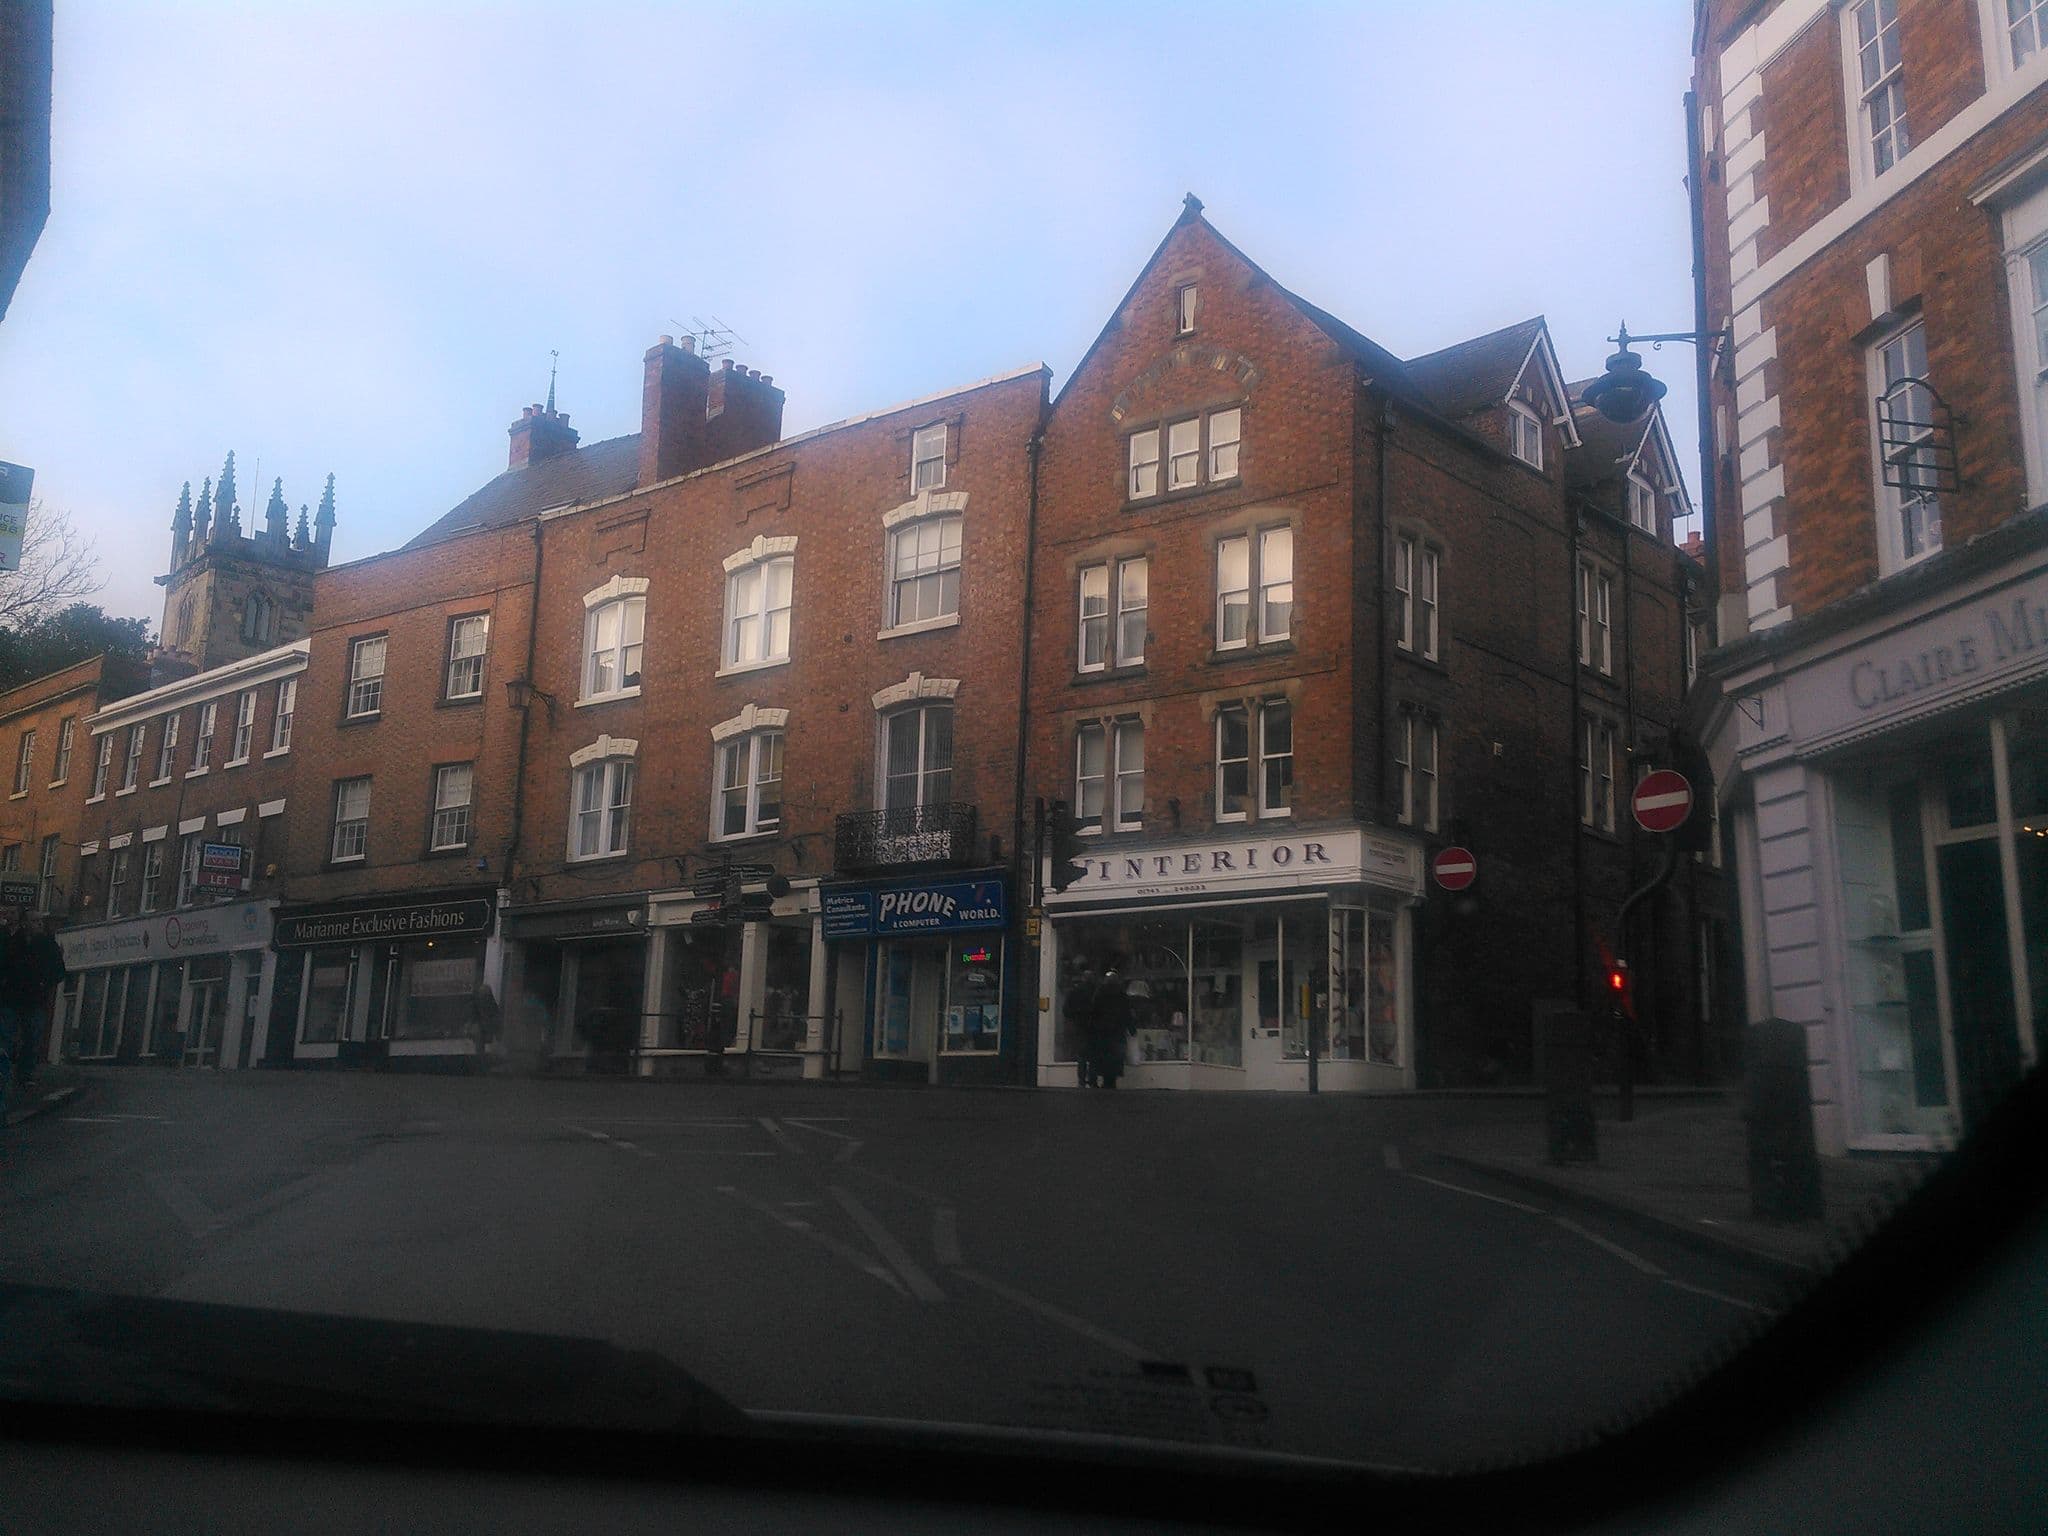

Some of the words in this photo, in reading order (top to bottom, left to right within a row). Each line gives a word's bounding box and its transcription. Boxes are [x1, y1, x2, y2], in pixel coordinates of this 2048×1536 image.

[1850, 637, 1978, 709] CLAIRE
[210, 875, 230, 885] LET
[19, 895, 34, 903] LET
[880, 892, 956, 922] PHONE
[294, 919, 353, 939] Marianne
[352, 914, 407, 934] Exclusive
[409, 909, 465, 930] Fashions
[898, 918, 941, 929] COMPUTER
